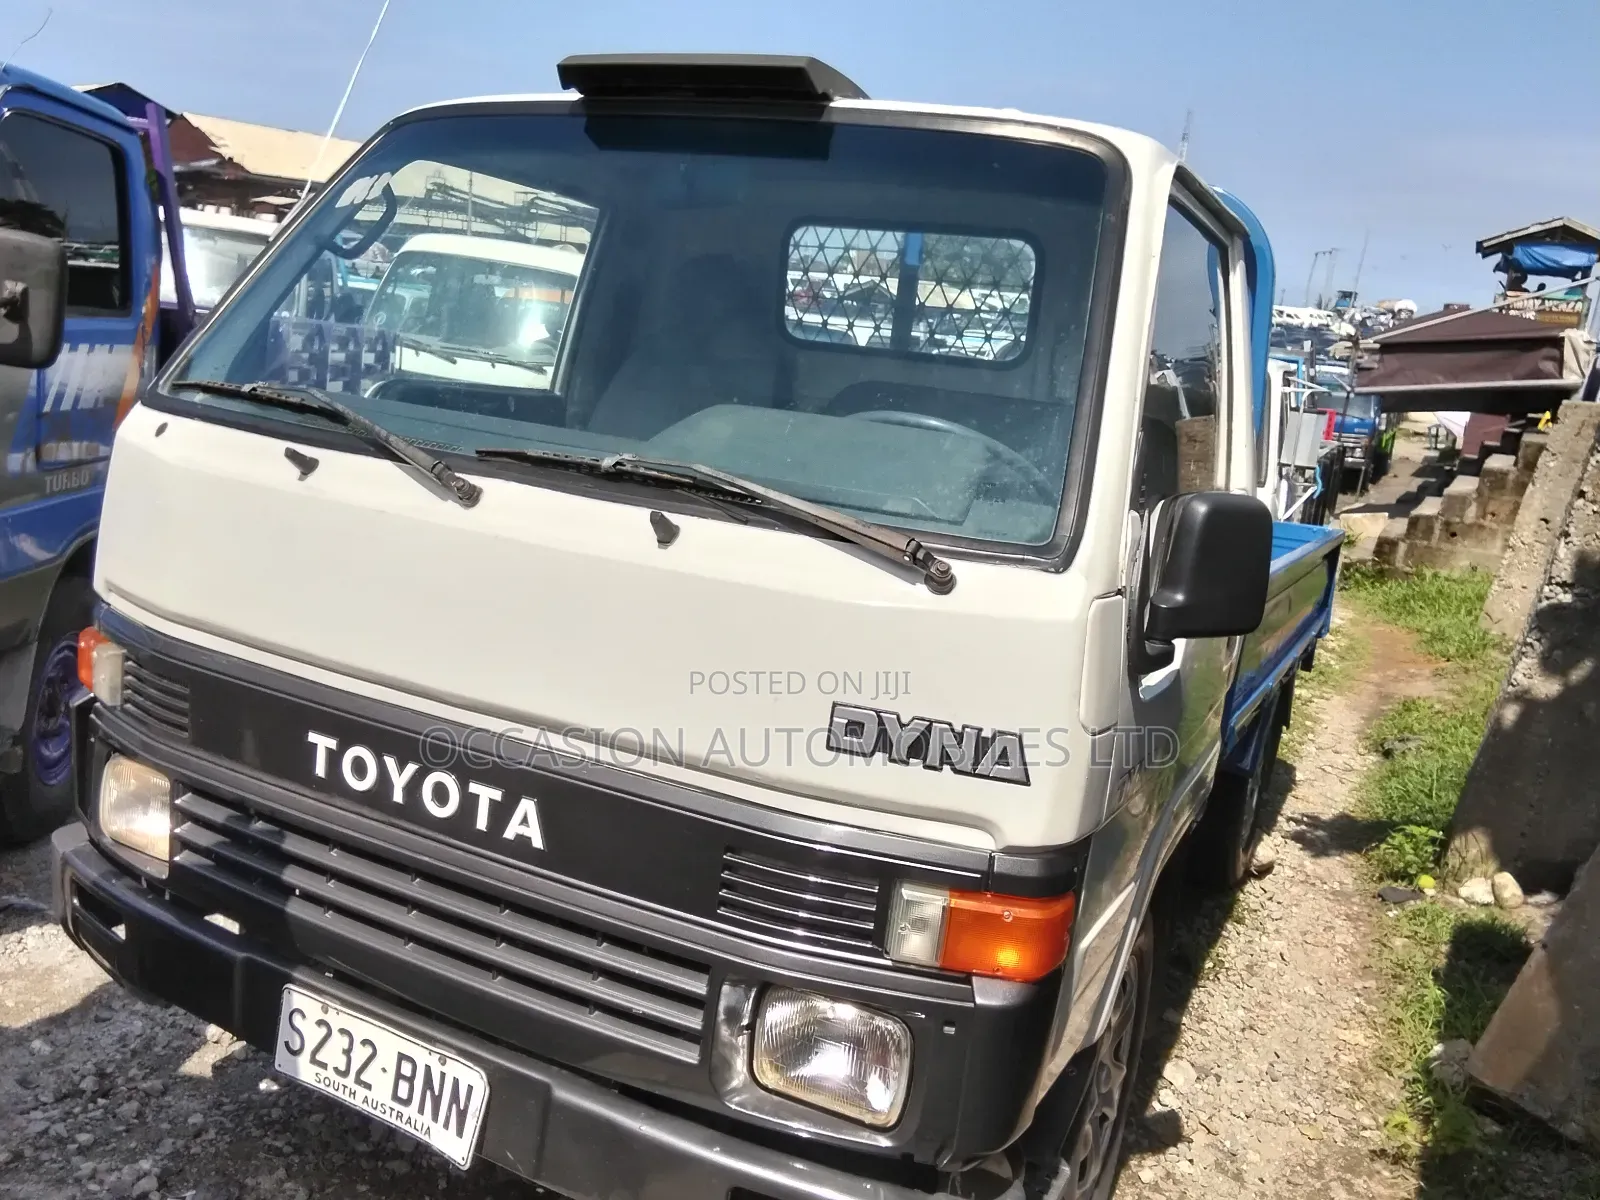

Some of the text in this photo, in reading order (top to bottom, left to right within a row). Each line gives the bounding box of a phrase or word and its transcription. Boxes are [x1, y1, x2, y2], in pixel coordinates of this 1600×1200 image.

[45, 470, 90, 493] TURBO
[826, 701, 1031, 787] DYNA
[306, 730, 547, 851] TOYOTA
[313, 1072, 432, 1138] SOUTH AUSTRALIA
